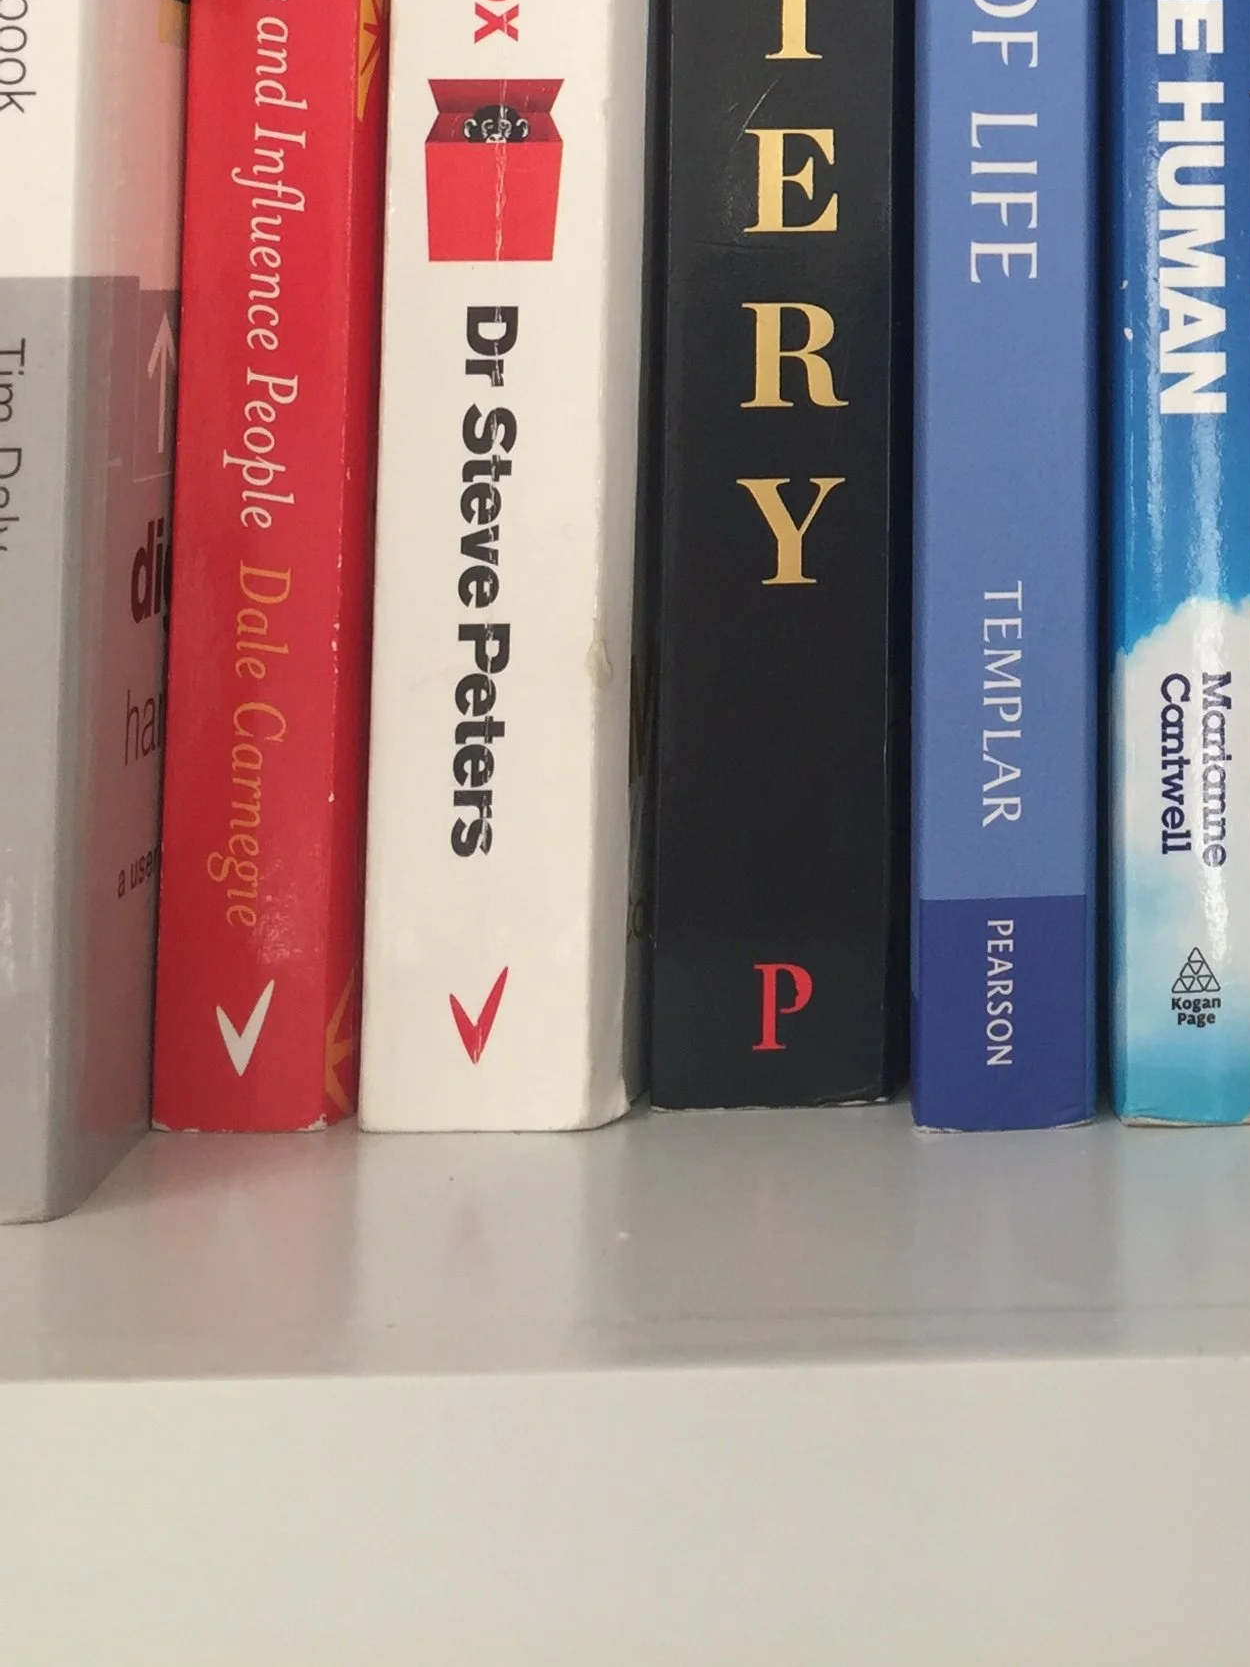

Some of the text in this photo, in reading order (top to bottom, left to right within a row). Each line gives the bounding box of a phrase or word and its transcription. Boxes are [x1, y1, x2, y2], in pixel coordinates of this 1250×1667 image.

[254, 16, 308, 108] and
[232, 119, 306, 350] Influence
[970, 110, 1039, 285] LIFE
[1157, 80, 1227, 415] HUMAN
[223, 367, 298, 531] People
[450, 306, 519, 859] Dr Steve Peters
[207, 559, 291, 928] Dale Carnegie
[982, 580, 1022, 828] TEMPLAR
[1160, 672, 1191, 855] Cantwell
[1202, 671, 1232, 869] Marianne
[118, 869, 126, 899] a
[751, 963, 813, 1051] P
[986, 919, 1014, 1067] PEARSON
[1171, 996, 1221, 1015] Kogan
[1177, 1010, 1215, 1027] Page
